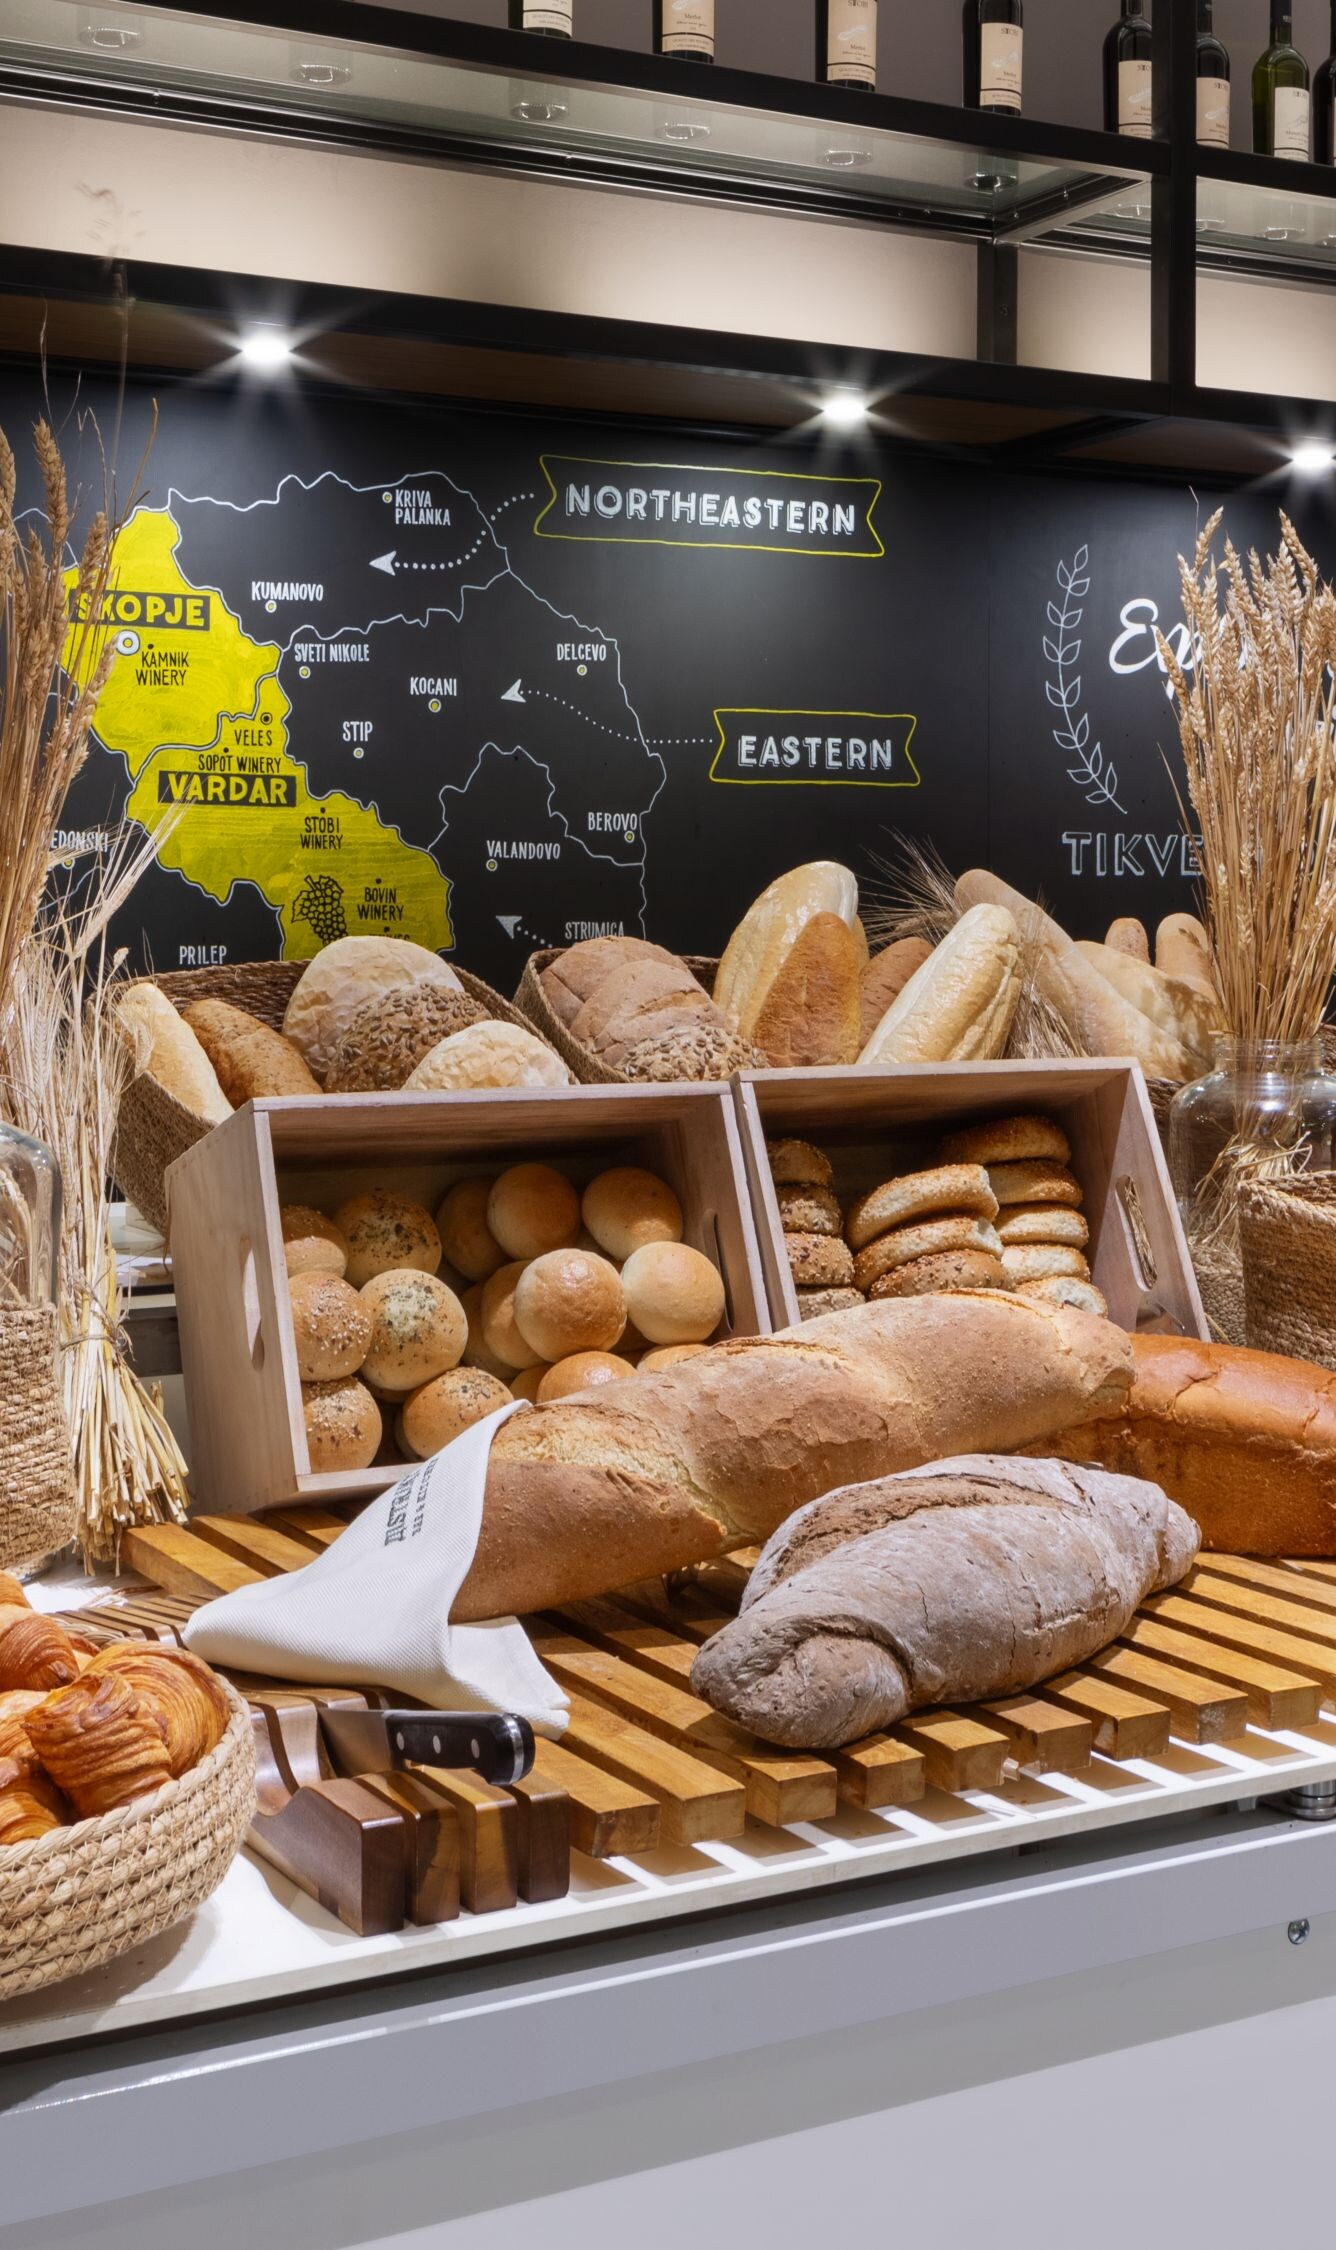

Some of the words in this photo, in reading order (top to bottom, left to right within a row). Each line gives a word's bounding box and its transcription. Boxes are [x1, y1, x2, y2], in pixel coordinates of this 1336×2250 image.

[395, 489, 432, 508] KRIVA
[395, 508, 451, 526] PALANKA
[565, 483, 855, 535] NORTHEASTERN
[251, 581, 324, 601] KUMANOVO
[77, 593, 205, 627] SKOPJE
[141, 651, 190, 668] KAMNIK
[294, 643, 326, 662] SVETI
[329, 644, 370, 663] NIKOLE
[556, 643, 607, 662] DELCEVO
[135, 669, 187, 686] WINERY
[410, 677, 458, 697] KOCANI
[234, 729, 273, 747] VELES
[342, 721, 373, 742] STIP
[737, 734, 893, 771] EASTERN
[198, 754, 232, 772] SOPOT
[237, 755, 282, 774] WINERY
[168, 772, 288, 805] VARDAR
[304, 816, 342, 834] STOBI
[587, 812, 638, 832] BEROVO
[50, 829, 109, 853] EDONSKI
[300, 834, 344, 851] WINERY
[486, 840, 561, 860] VALANDOVO
[1062, 831, 1205, 877] TIKVE
[364, 887, 397, 904] BOVIN
[357, 904, 404, 921] WINERY
[564, 921, 625, 940] STRUMICA
[178, 945, 228, 965] PRILEP
